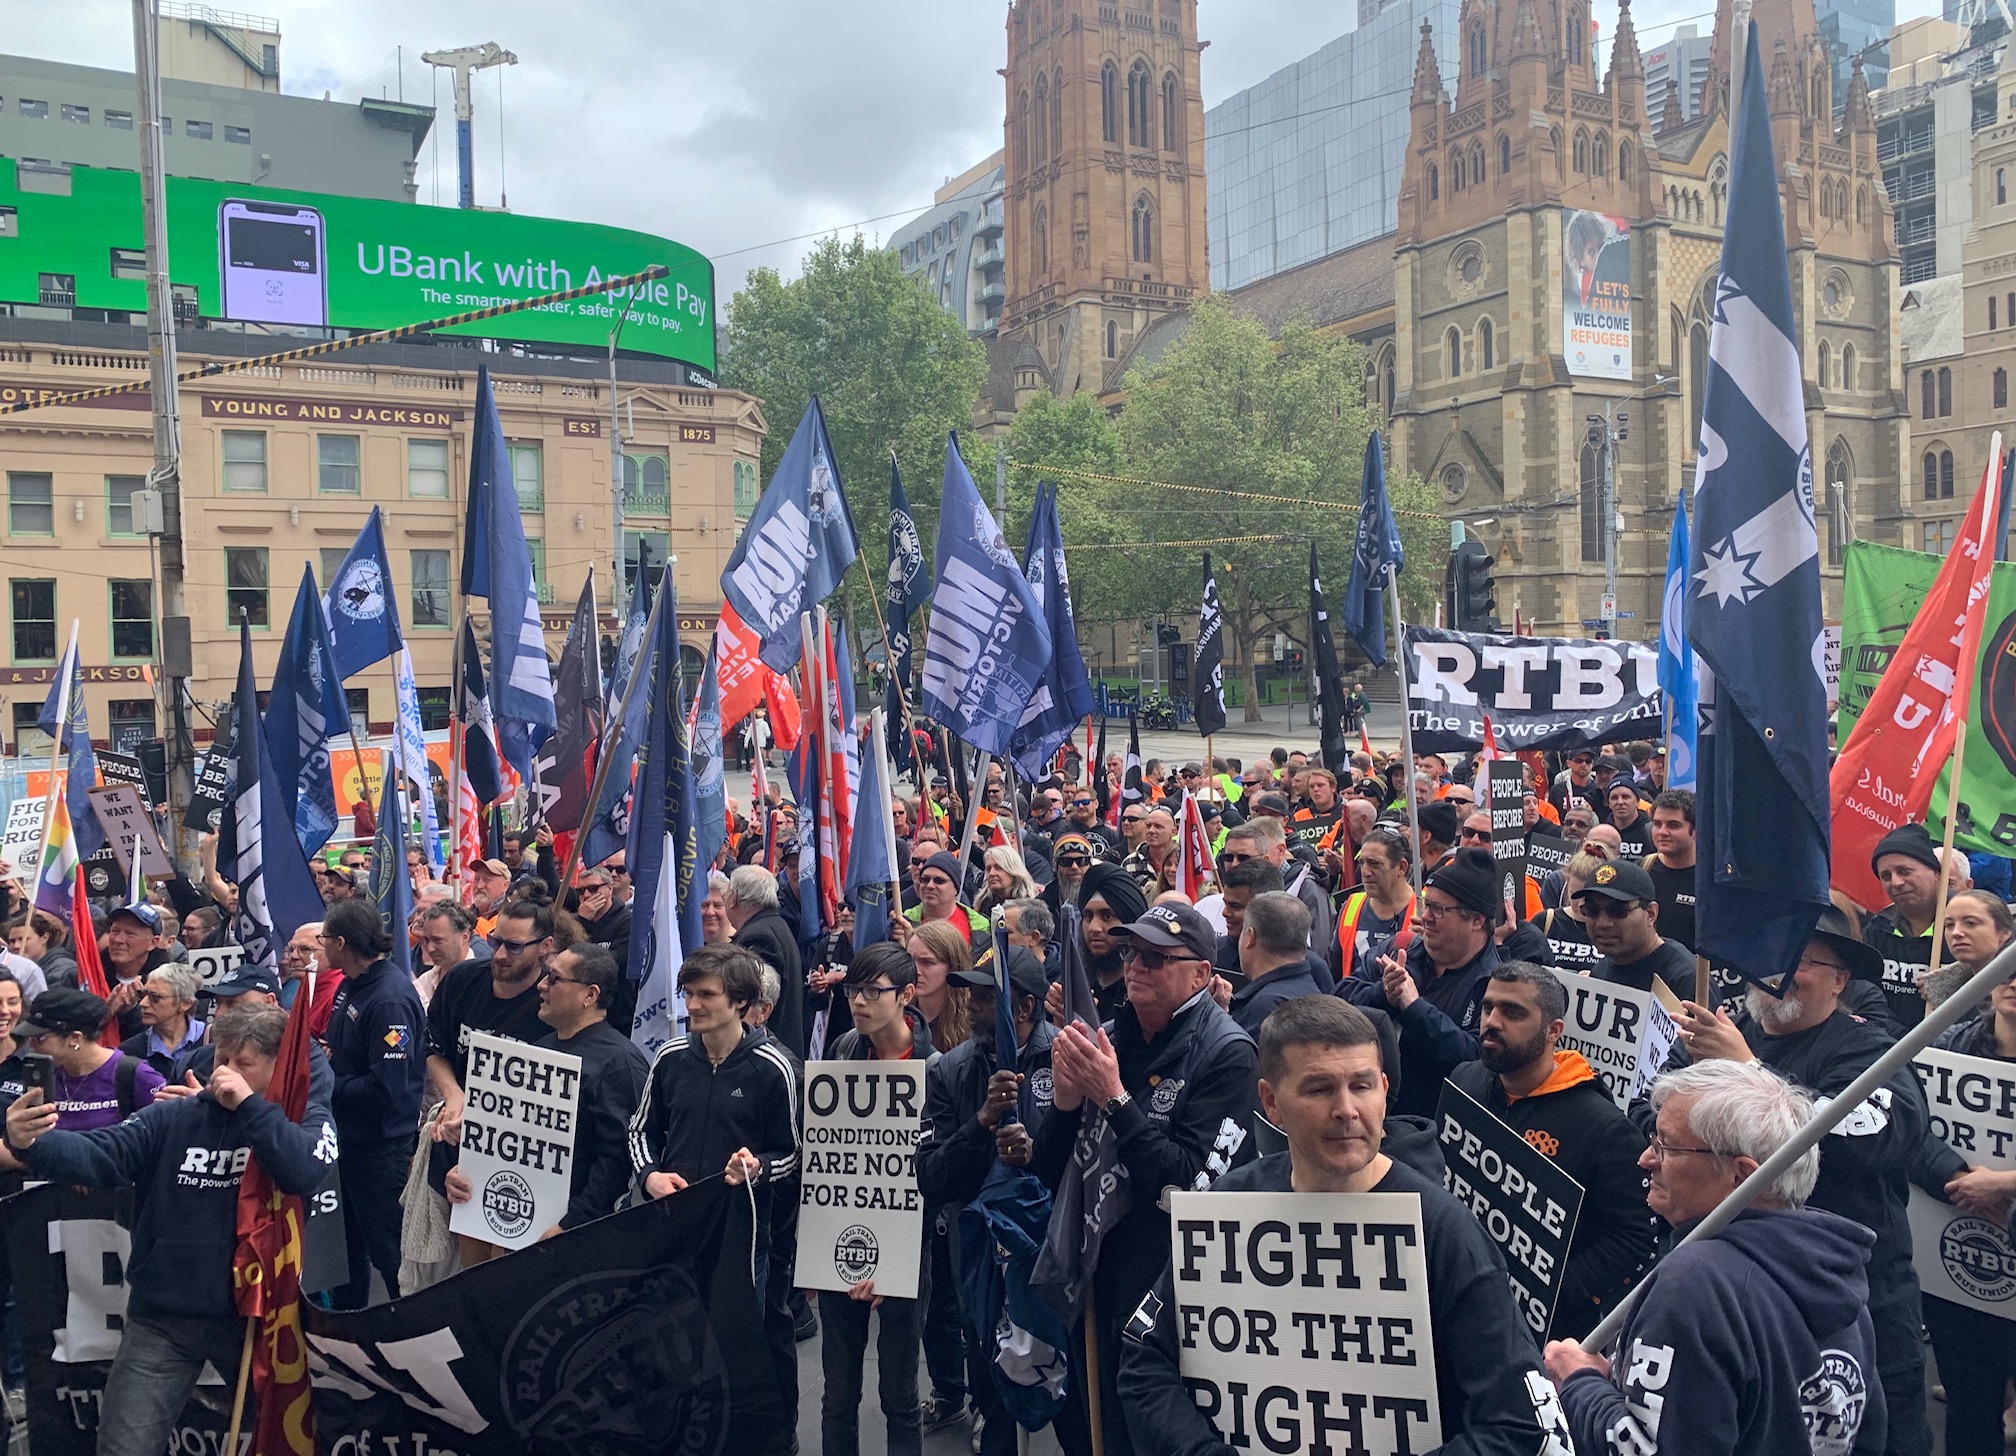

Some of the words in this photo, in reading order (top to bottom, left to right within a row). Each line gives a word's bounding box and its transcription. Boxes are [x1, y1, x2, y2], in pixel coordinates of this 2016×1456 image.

[293, 260, 310, 268] VISA
[358, 242, 485, 285] UBank
[494, 258, 570, 291] with
[584, 264, 668, 309] Apple
[676, 281, 706, 326] Pay
[1595, 280, 1630, 298] LET'S
[420, 288, 451, 305] The
[578, 301, 615, 318] safer
[618, 308, 644, 326] way
[647, 313, 660, 326] to
[662, 317, 683, 333] pay.
[1591, 297, 1630, 314] FULLY
[1573, 311, 1630, 331] WELCOME
[1570, 329, 1630, 348] REFUGEES
[210, 400, 289, 417] YOUNG
[298, 405, 342, 421] AND
[349, 409, 451, 427] JACKSON
[683, 429, 711, 441] 1875
[12, 672, 23, 682] &
[1410, 709, 1460, 731] The
[1468, 717, 1566, 738] power
[1572, 716, 1604, 731] of
[99, 759, 142, 779] PEOPLE
[104, 793, 121, 804] WE
[1491, 778, 1522, 799] PEOPLE
[9, 816, 39, 829] FOR
[104, 805, 134, 818] WANT
[1492, 808, 1524, 830] BEFORE
[122, 820, 131, 830] A
[1492, 837, 1525, 860] PROFITS
[1529, 844, 1572, 866] PEOPLE
[1564, 987, 1641, 1045] UR
[1650, 1000, 1676, 1046] UNITED
[383, 1052, 408, 1060] AMWU
[471, 1046, 579, 1101] FIGHT
[808, 1073, 918, 1118] OUR
[1153, 1090, 1178, 1101] RTBU
[468, 1086, 514, 1119] FOR
[520, 1100, 571, 1133] THE
[462, 1119, 570, 1175] RIGHT
[805, 1127, 921, 1147] CONDITIONS
[805, 1151, 858, 1175] ARE
[864, 1153, 917, 1178] NOT
[177, 1174, 199, 1187] The
[490, 1175, 509, 1189] RAIL
[509, 1175, 530, 1198] TRAM
[1440, 1112, 1567, 1240] PEOPLE
[484, 1190, 533, 1219] RTBU
[801, 1183, 849, 1207] FOR
[854, 1185, 919, 1212] SALE
[490, 1217, 503, 1233] BUS
[503, 1220, 527, 1235] UNION
[840, 1228, 857, 1244] RAIL
[856, 1228, 874, 1245] TRAM
[1443, 1165, 1556, 1287] BEFORE
[1950, 1221, 1977, 1237] RAIL
[836, 1246, 878, 1263] RTBU
[1177, 1219, 1417, 1292] FIGHT
[1955, 1270, 1976, 1292] BUS
[1179, 1304, 1279, 1356] FOR
[1291, 1311, 1417, 1367] THE
[1825, 1359, 1860, 1391] TRAM
[1181, 1376, 1430, 1456] RIGHT
